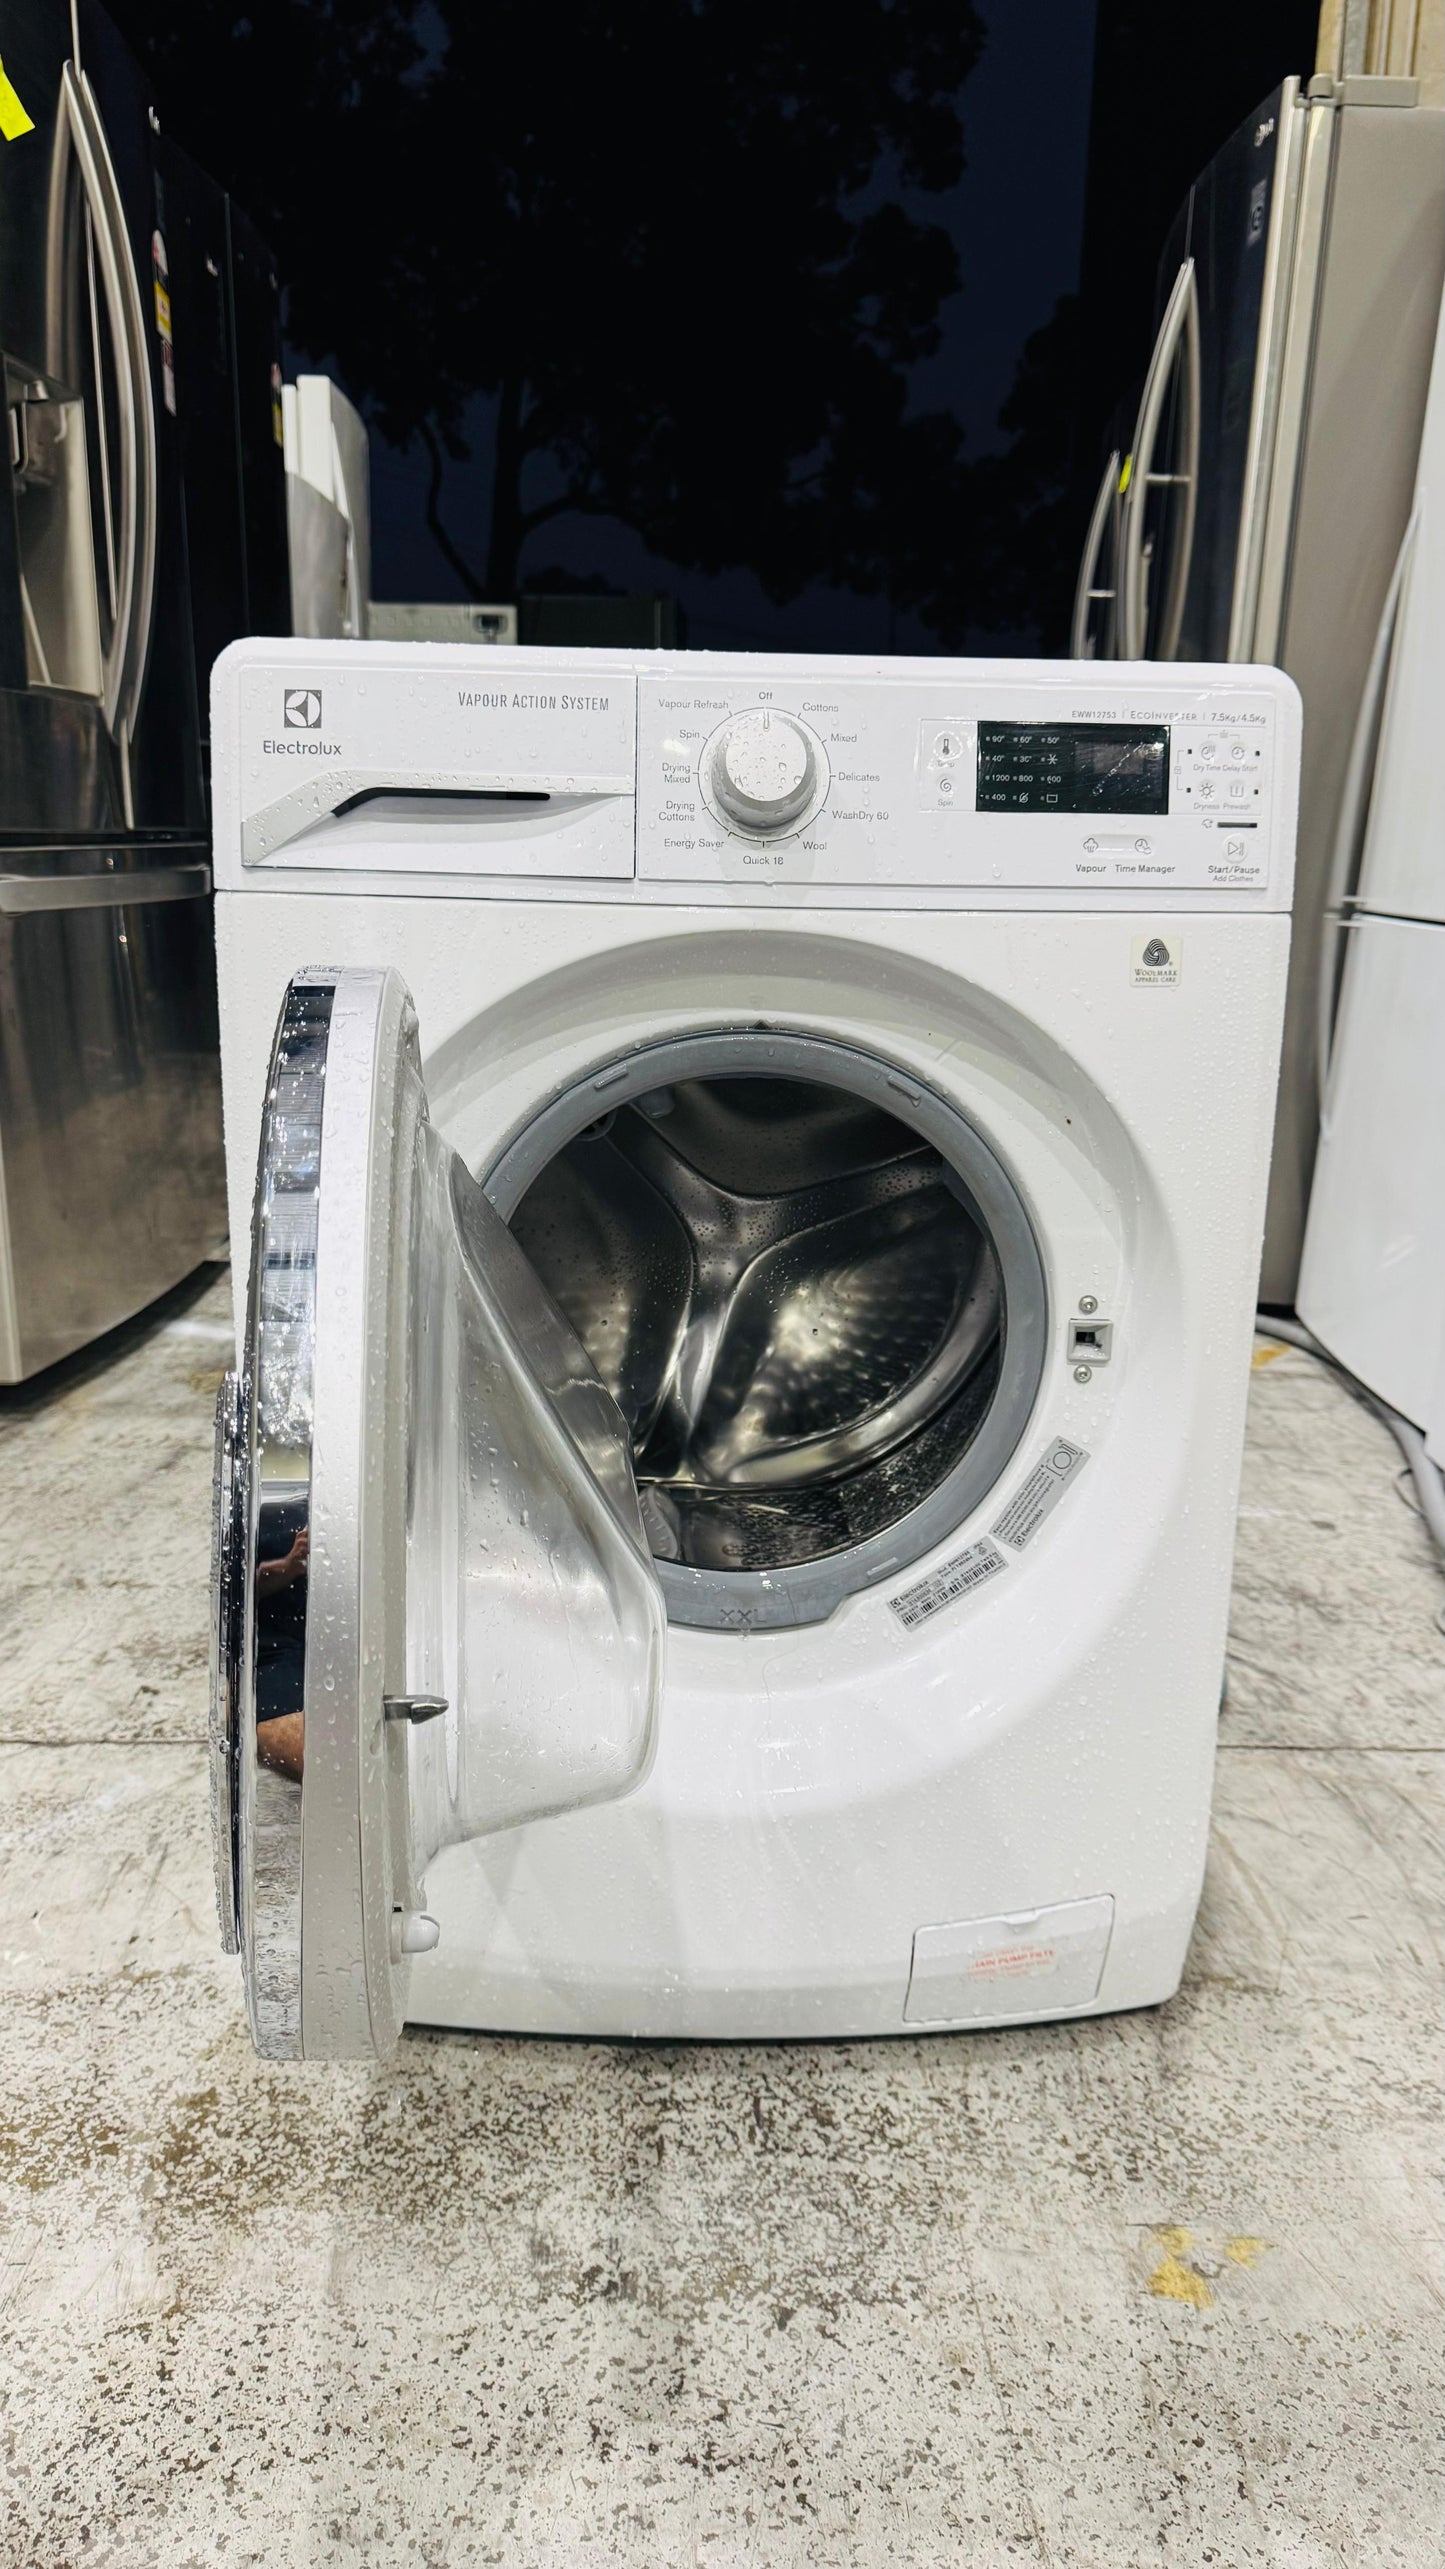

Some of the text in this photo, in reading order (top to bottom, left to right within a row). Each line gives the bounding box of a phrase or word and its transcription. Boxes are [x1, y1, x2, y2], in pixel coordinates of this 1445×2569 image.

[758, 691, 773, 700] Off
[458, 691, 609, 711] VAPOUR ACTION SYSTEM
[658, 699, 729, 710] Vapour Refresh
[802, 702, 839, 713] Cottons
[1071, 710, 1117, 719] EWW12753
[679, 729, 700, 739] Spin
[830, 733, 858, 743] Mixed
[262, 740, 342, 756] Electrolux
[662, 762, 691, 774] Drying
[664, 774, 691, 784] Mixed
[838, 772, 880, 782] Delicates
[991, 774, 1010, 782] 1200
[1019, 774, 1033, 782] 800
[991, 793, 1006, 801] 400
[665, 801, 695, 812] Drying
[658, 812, 695, 822] Cottons
[832, 810, 889, 822] WashDry 60
[664, 839, 725, 850] Energy Saver
[802, 841, 828, 850] Wool
[742, 855, 784, 865] Quick 18
[1075, 864, 1107, 873] Vapour
[1115, 864, 1176, 874] Time Manager
[1207, 865, 1260, 875] Start/Pause
[1021, 1509, 1043, 1536] Electrolux
[719, 1608, 767, 1624] XXL
